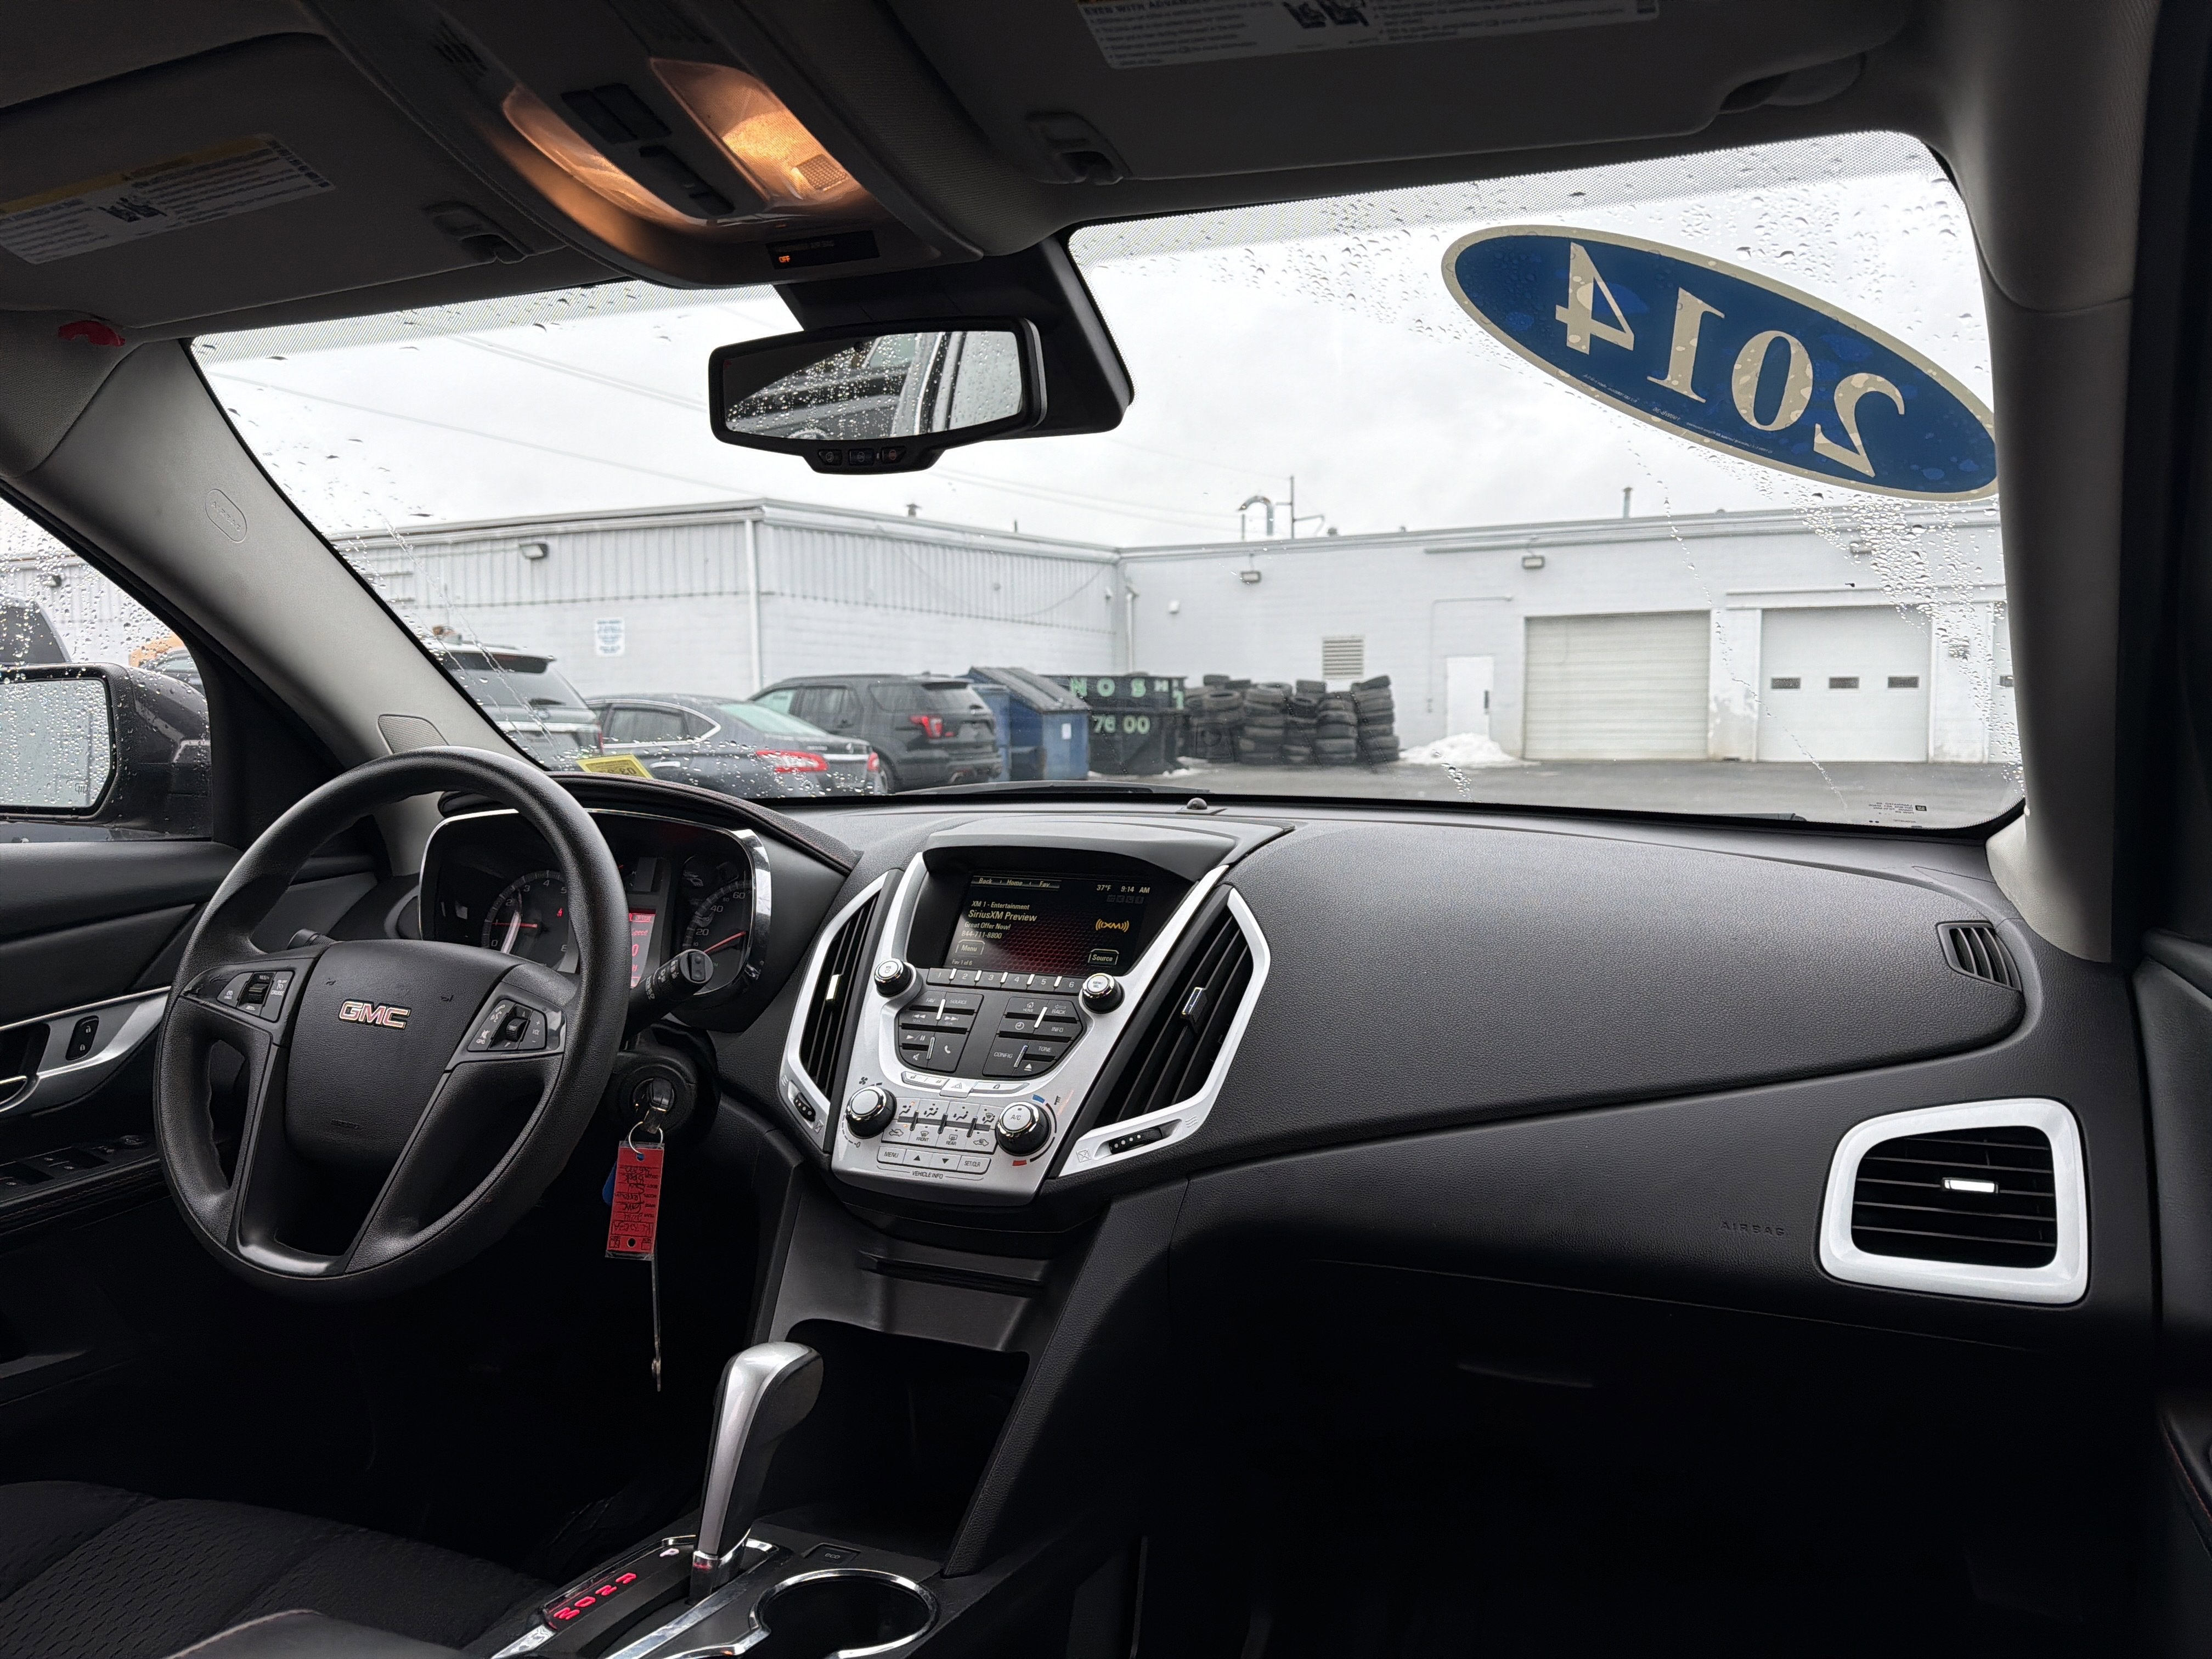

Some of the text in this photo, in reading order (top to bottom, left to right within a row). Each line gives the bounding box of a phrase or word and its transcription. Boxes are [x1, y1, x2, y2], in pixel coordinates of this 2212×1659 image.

[778, 255, 791, 263] OFF
[991, 901, 1030, 910] Entertainment
[968, 909, 1037, 922] SiriusXM Preview
[961, 930, 1002, 939] 844-711-8800
[339, 1001, 411, 1029] GMC
[1720, 1222, 1784, 1235] AIRBAG
[659, 1548, 680, 1558] P
[595, 1584, 617, 1596] N
[554, 1607, 580, 1620] M
